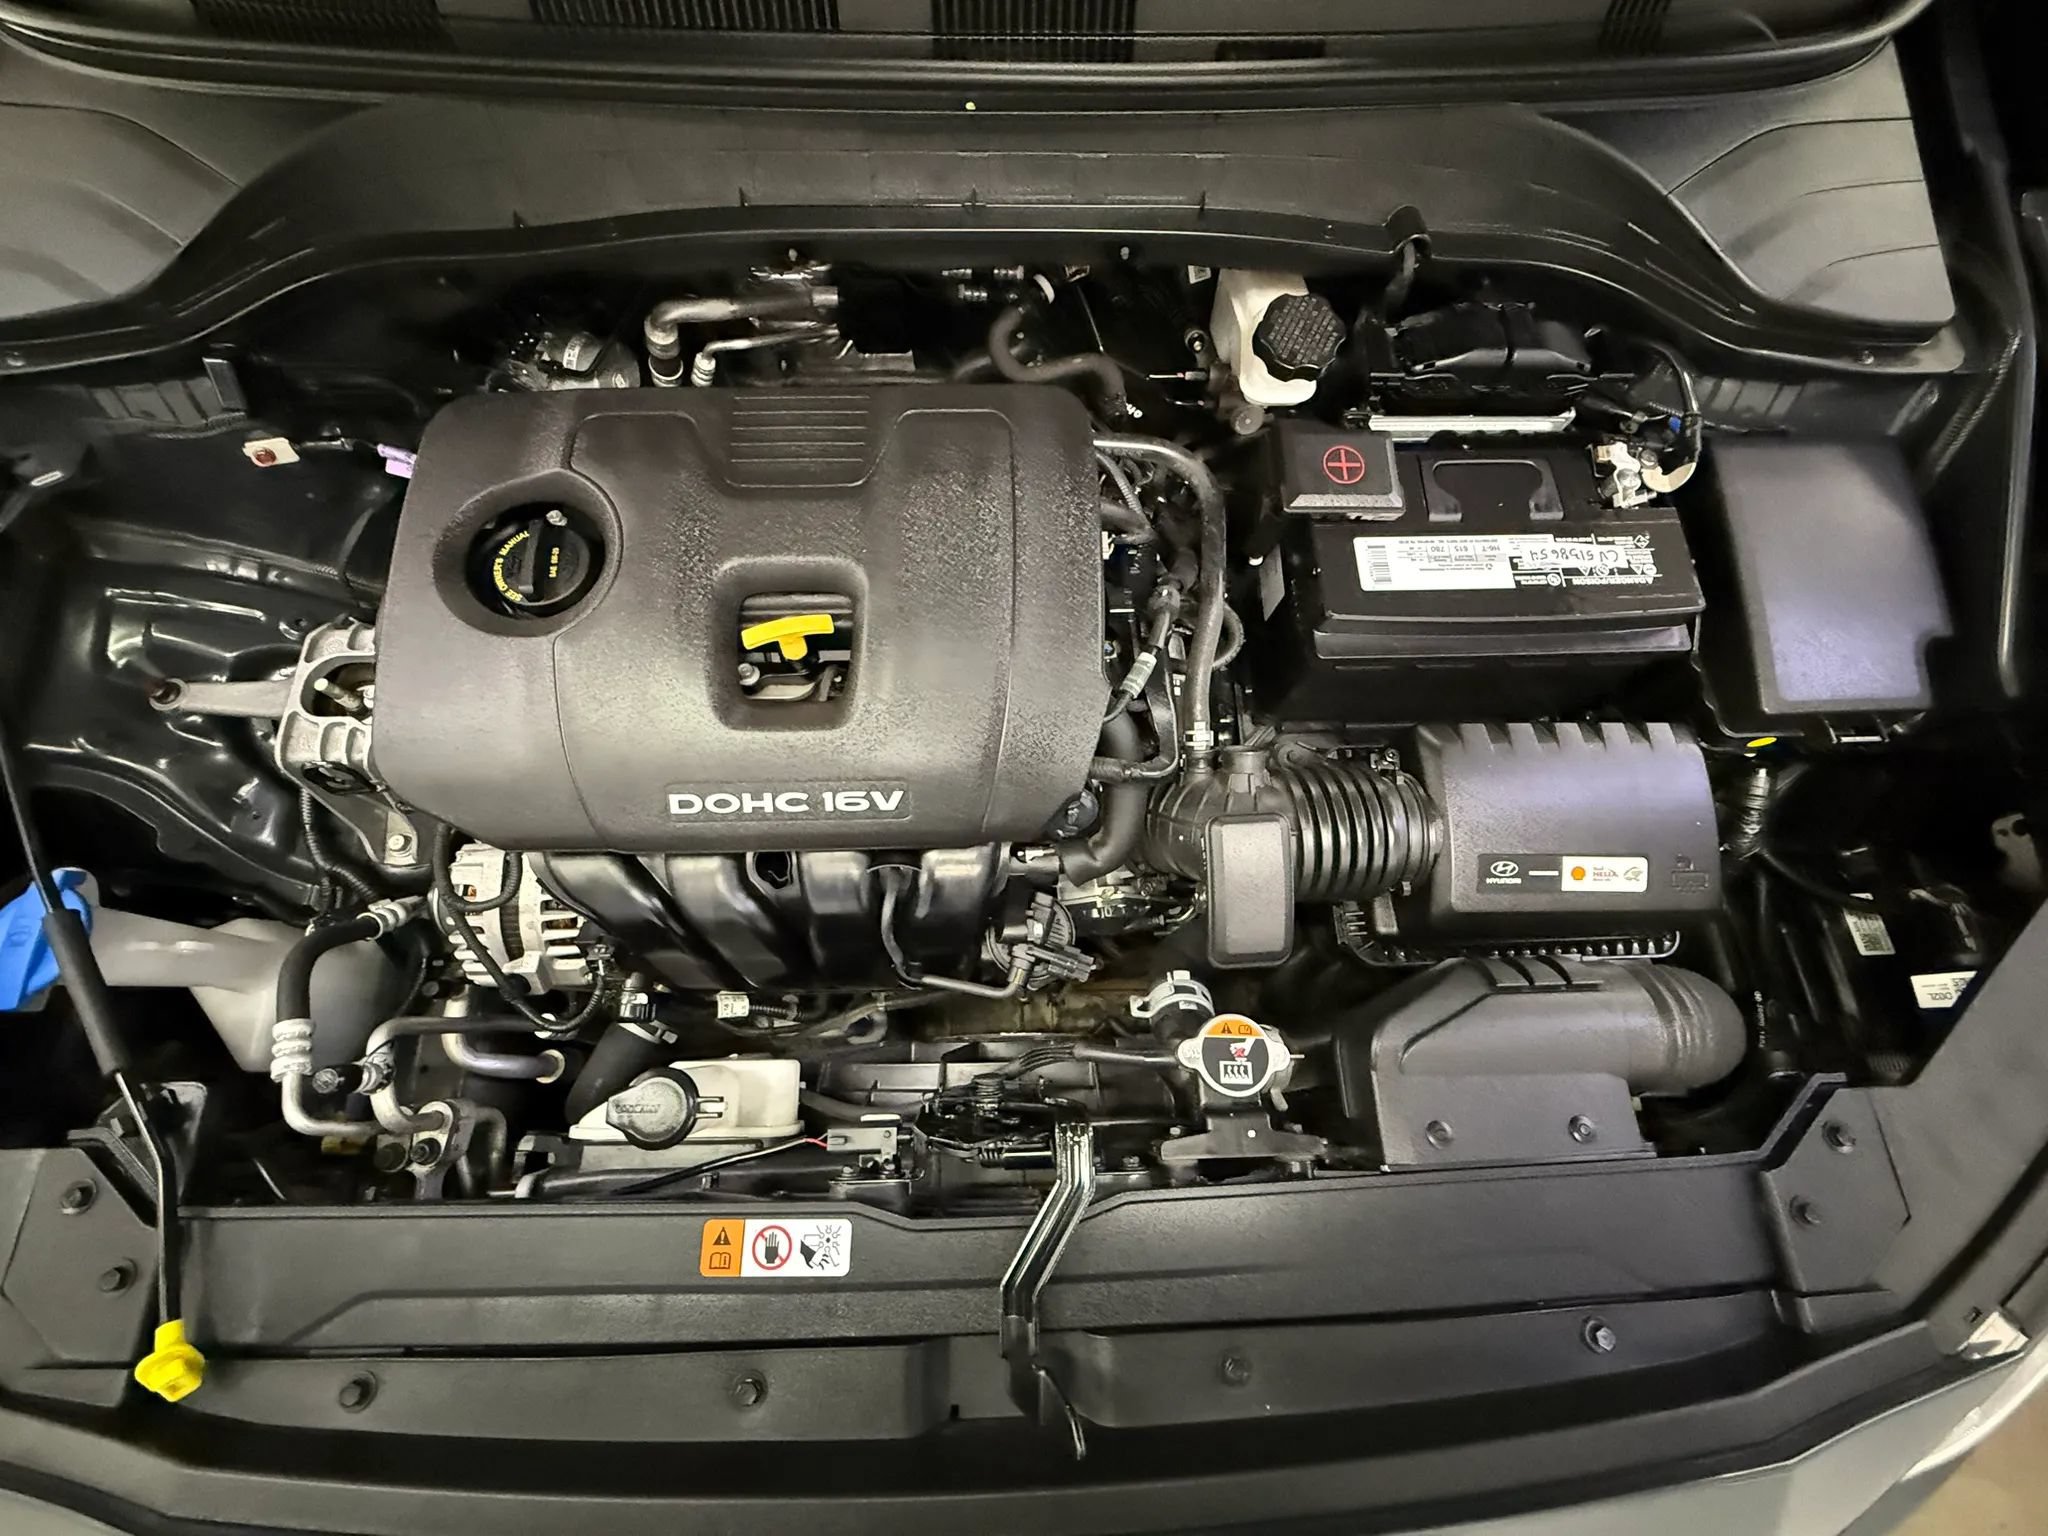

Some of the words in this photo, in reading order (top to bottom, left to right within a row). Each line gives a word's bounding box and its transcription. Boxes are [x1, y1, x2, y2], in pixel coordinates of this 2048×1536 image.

[498, 530, 530, 556] MANUAL
[1599, 549, 1619, 562] CV
[493, 557, 509, 592] OWNER'S
[505, 589, 523, 602] SEE
[668, 792, 810, 815] DOHC
[822, 790, 905, 812] 16V
[1486, 877, 1522, 885] HYUNDAI
